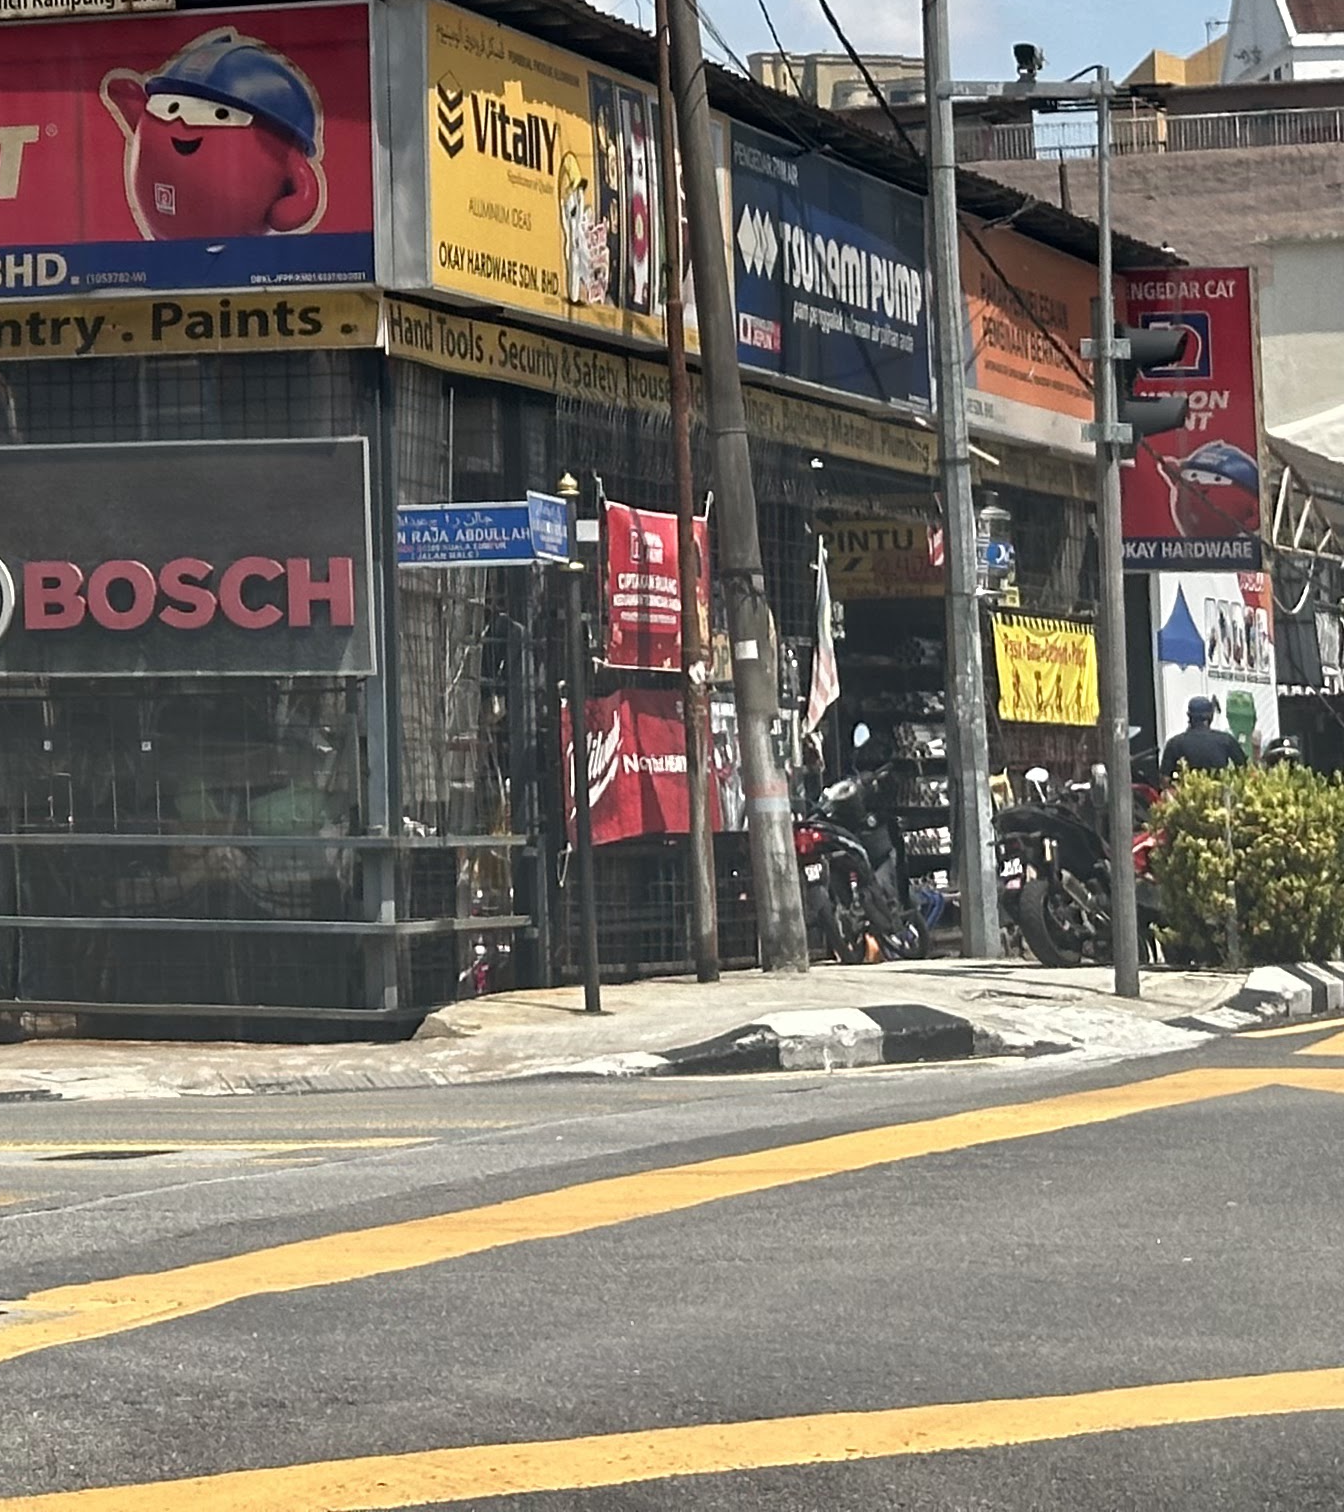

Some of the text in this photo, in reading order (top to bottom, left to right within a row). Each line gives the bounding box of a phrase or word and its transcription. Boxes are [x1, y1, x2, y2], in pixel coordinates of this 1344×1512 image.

[439, 240, 465, 269] OKAY
[467, 244, 519, 287] HARDWARE
[1126, 279, 1236, 300] ENGEDAR CAT
[151, 297, 322, 341] Paints
[388, 304, 433, 350] Hand
[437, 314, 484, 364] Tools
[498, 329, 559, 386] Security
[561, 354, 571, 382] &
[572, 349, 619, 398] Safety
[411, 528, 450, 544] RAJA
[455, 527, 531, 543] ABDULLAH
[1161, 541, 1253, 560] HARDWARE
[23, 554, 355, 632] BOSCH
